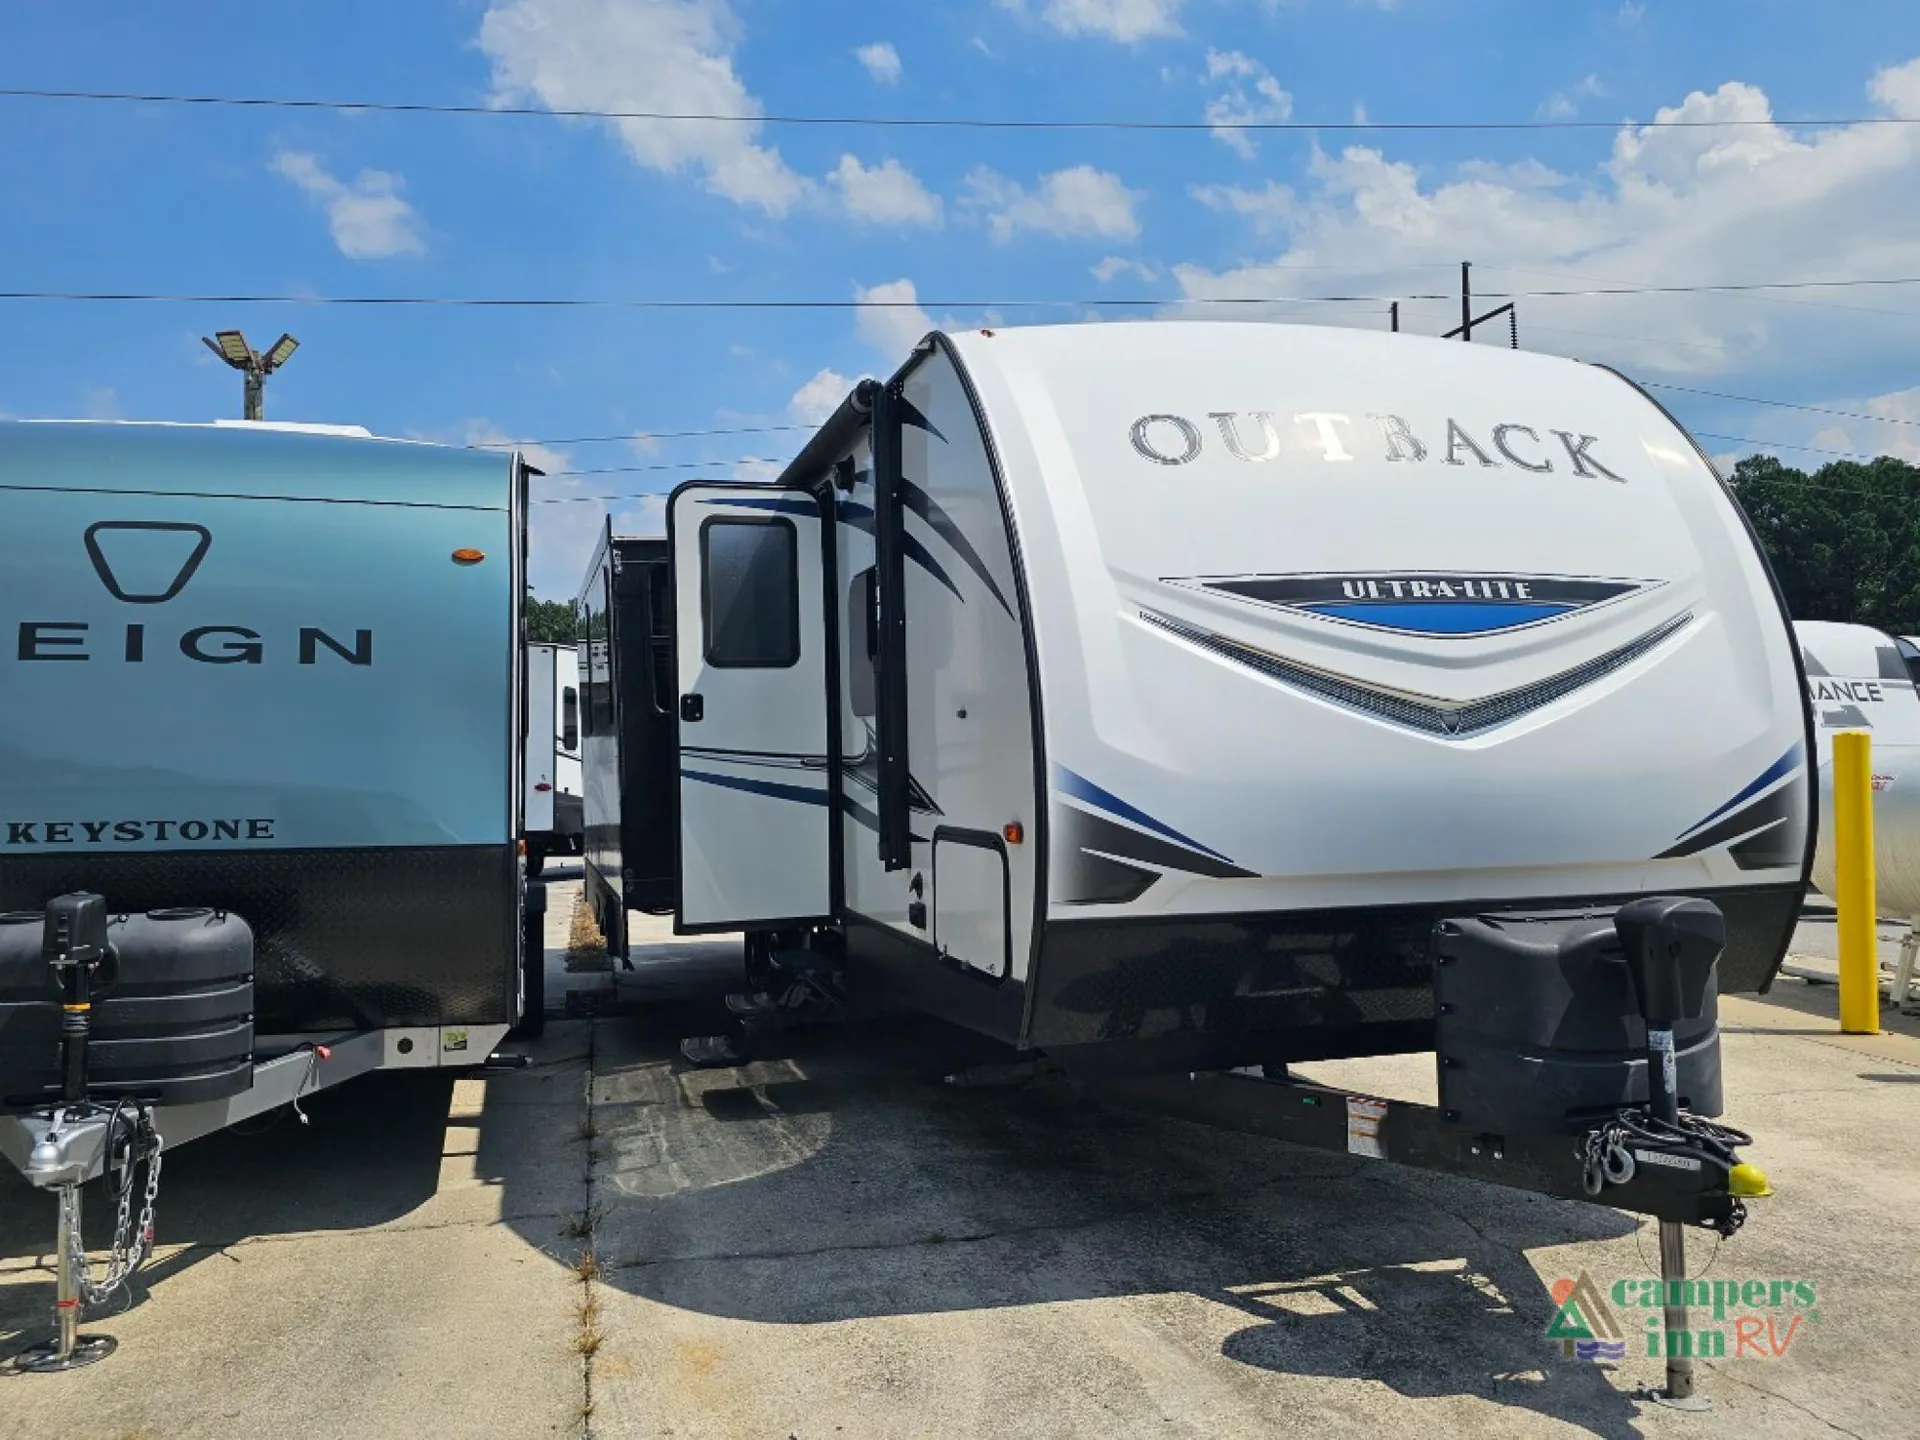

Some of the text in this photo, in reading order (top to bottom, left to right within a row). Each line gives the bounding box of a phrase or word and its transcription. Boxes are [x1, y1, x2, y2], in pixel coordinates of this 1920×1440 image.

[1130, 411, 1627, 484] OUTBACK
[1342, 580, 1532, 600] ULTRA-LITE
[7, 818, 275, 844] KEYSTONE
